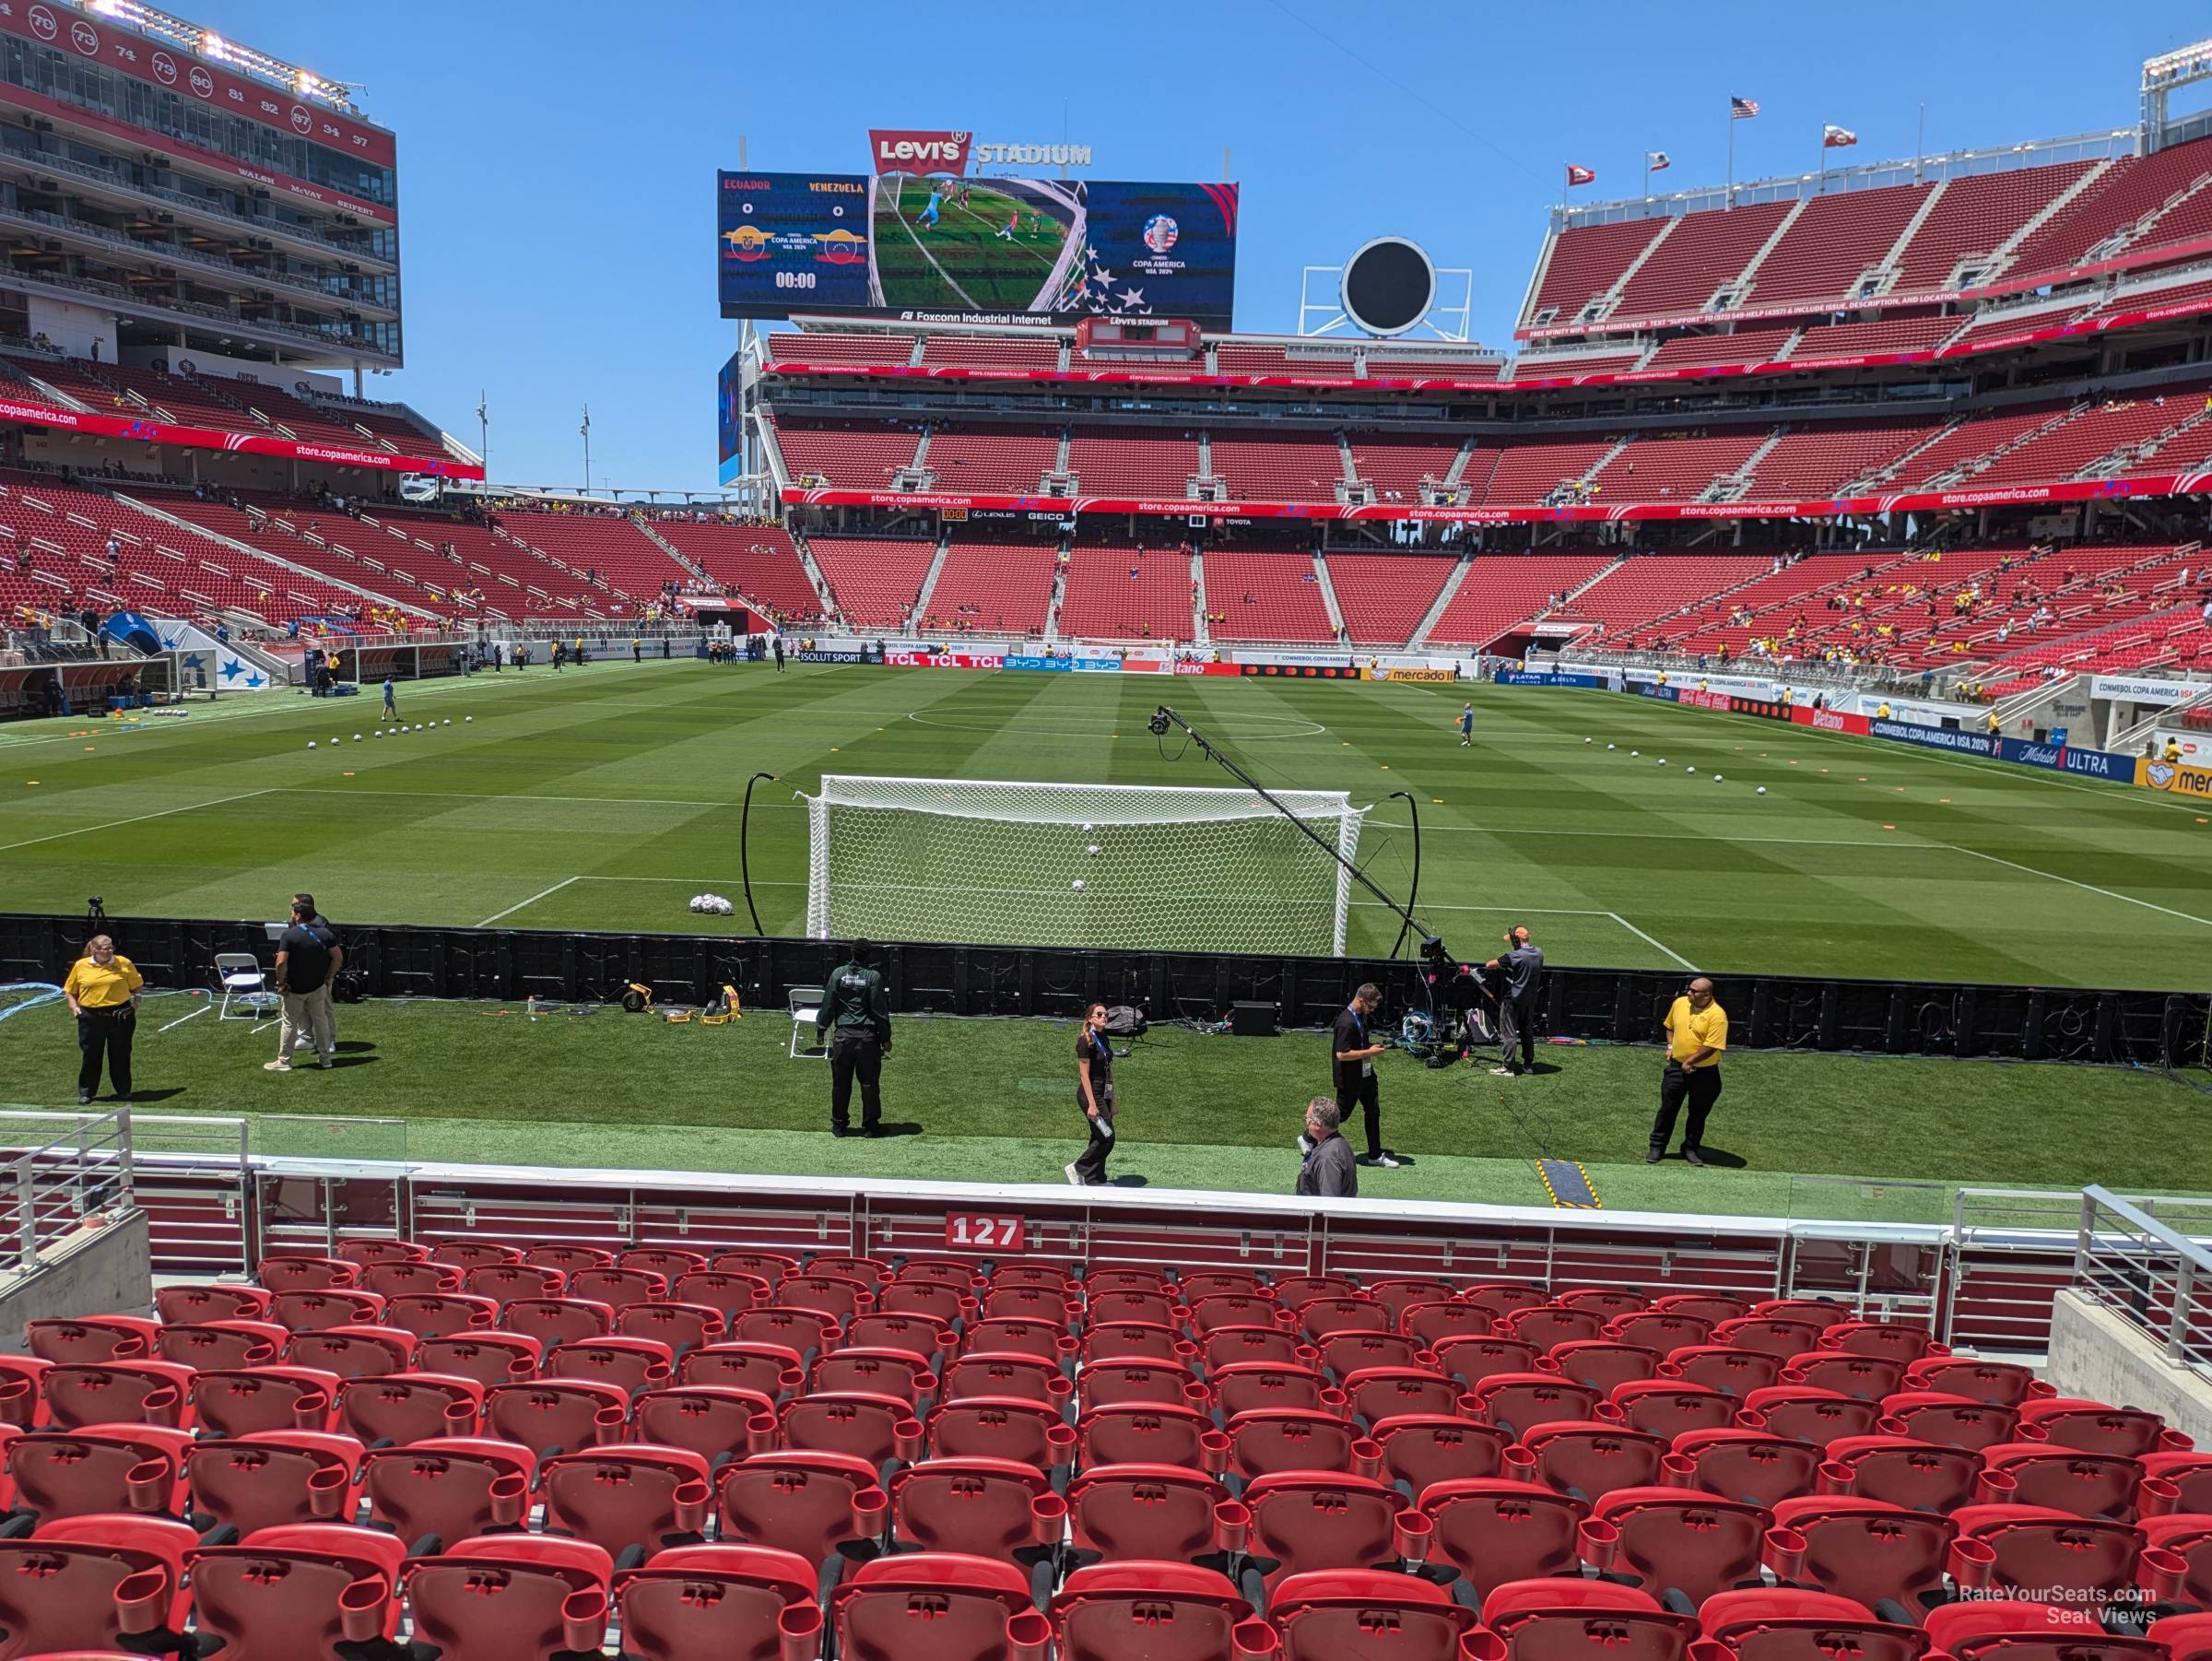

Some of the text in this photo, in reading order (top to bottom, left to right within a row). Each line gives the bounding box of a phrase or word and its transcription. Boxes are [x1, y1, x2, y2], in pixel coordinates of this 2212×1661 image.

[30, 14, 55, 31] 70
[73, 29, 98, 46] 73
[115, 45, 137, 62] 74
[153, 60, 176, 77] 79
[192, 75, 213, 89] 80
[292, 112, 310, 125] 87
[977, 143, 1091, 165] STADIUM
[238, 168, 276, 185] WALSH
[724, 179, 771, 190] ECUADOR
[809, 183, 864, 194] VENEZUELA
[290, 184, 323, 200] McVAY
[337, 199, 375, 217] SEIFERT
[742, 203, 754, 214] 0
[832, 206, 844, 217] 0
[790, 237, 818, 245] AMERICA
[1133, 260, 1152, 268] COPA
[776, 271, 817, 289] 00:00
[1794, 304, 1825, 314] INCLUDE
[1849, 298, 1901, 310] DESCRIPTION,
[1901, 296, 1919, 304] AND
[1920, 292, 1961, 302] LOCATION.
[916, 312, 961, 323] Foxconn
[963, 312, 1010, 324] Industrial
[1012, 313, 1052, 325] Internet
[1971, 334, 2033, 350] store.copaamerica.com
[808, 365, 869, 373] store.copaamerica.com
[1791, 358, 1865, 369] store.copaamerica.com
[1129, 374, 1191, 383] store.copaamerica.com
[1291, 378, 1353, 386] store.copaamerica.com
[1614, 371, 1678, 381] store.copaamerica.com
[296, 445, 390, 465] store.copaamerica.com
[871, 494, 971, 505] store.copaamerica.com
[1942, 487, 2049, 504] store.copaamerica.com
[1139, 502, 1241, 512] store.copaamerica.com
[1680, 504, 1796, 517] store.copaamerica.com
[1028, 512, 1065, 521] GEICO
[1409, 509, 1510, 520] store.copaamerica.com
[832, 654, 861, 663] SPORT
[885, 654, 920, 666] TCL
[927, 654, 961, 667] TCL
[969, 656, 1003, 668] TCL
[1045, 660, 1079, 668] BYD
[1085, 661, 1120, 669] BYD
[1394, 670, 1444, 681] mercado
[2100, 683, 2132, 693] CONMEBOL
[2133, 685, 2150, 695] COPA
[2150, 687, 2179, 697] AMERICA
[1812, 709, 1843, 730] Betano
[1875, 722, 1990, 751] CONMEBOL COPA AMERICA USA 2024
[2018, 744, 2110, 774] Michelob ULTRA
[952, 1217, 1018, 1245] 127
